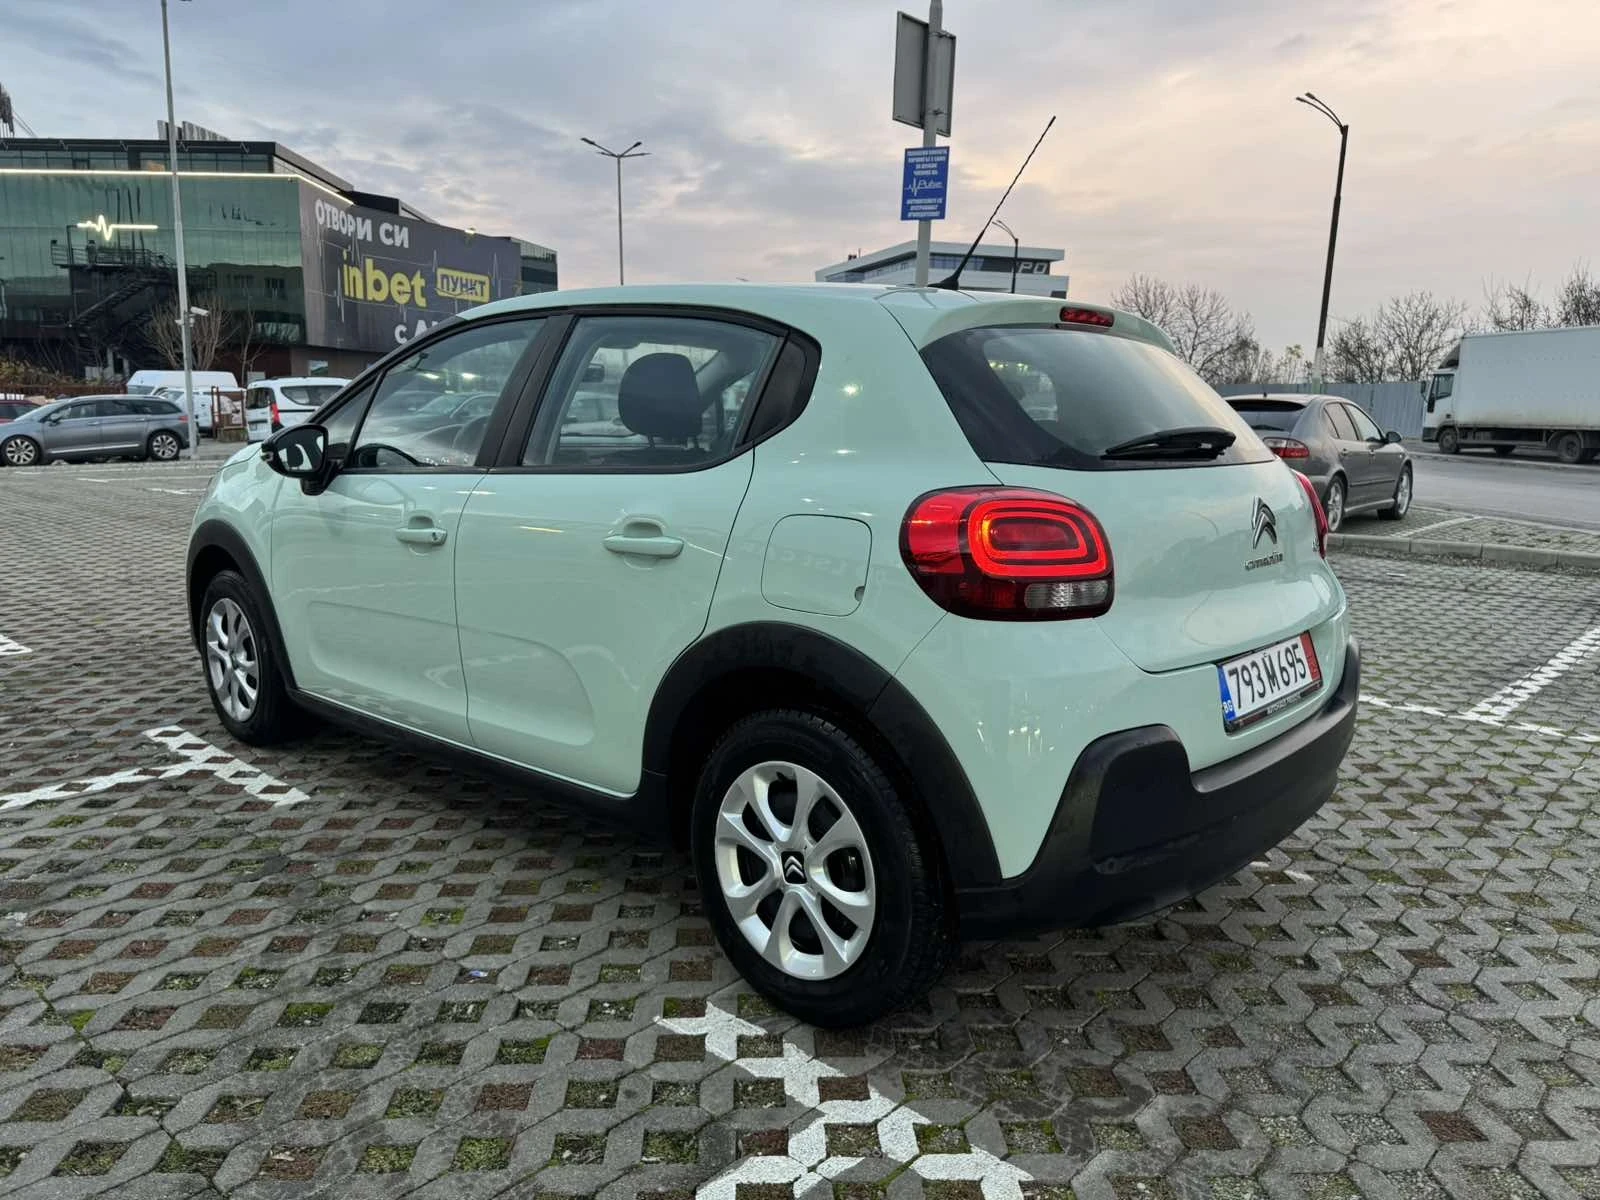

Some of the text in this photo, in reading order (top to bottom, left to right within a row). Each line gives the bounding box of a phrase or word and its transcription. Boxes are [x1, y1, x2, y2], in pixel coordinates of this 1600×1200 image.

[315, 199, 409, 249] ОТВОРИ СИ
[343, 249, 427, 308] inbet
[440, 273, 486, 298] ПУНКТ
